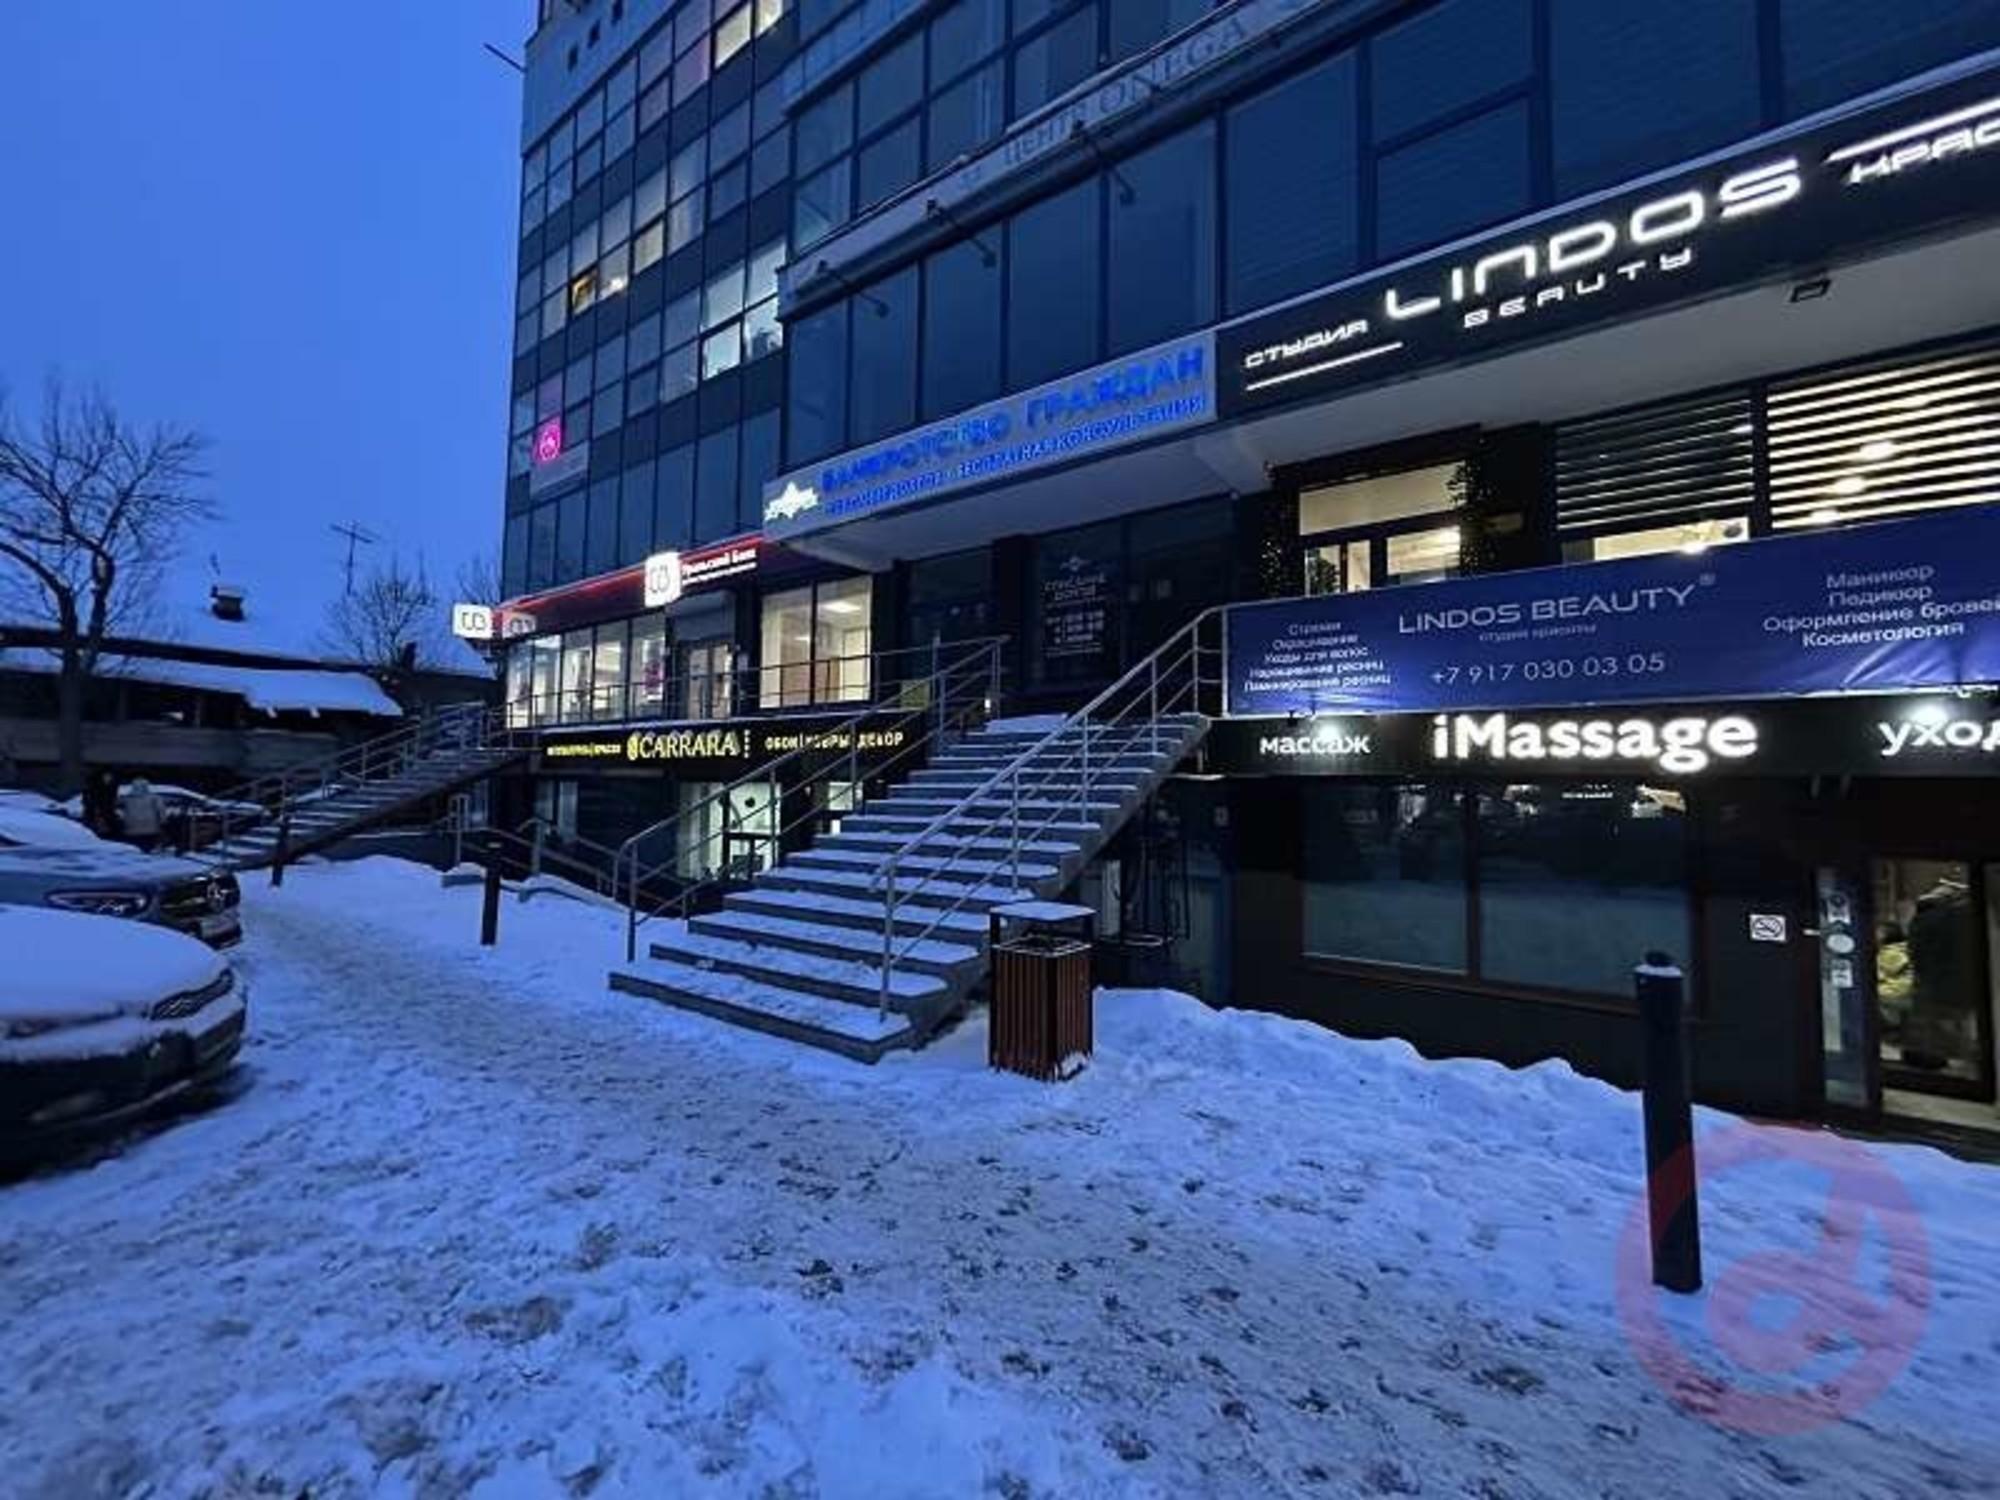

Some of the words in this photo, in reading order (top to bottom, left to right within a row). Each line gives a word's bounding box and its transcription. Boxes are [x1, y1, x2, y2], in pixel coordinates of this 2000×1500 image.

[1385, 157, 1802, 319] LINDOS
[1463, 247, 1691, 328] BEAUTY
[1245, 319, 1369, 368] СТУДИЯ
[1399, 604, 1522, 634] LINDOS
[1531, 583, 1696, 621] BEAUTY
[1763, 607, 1914, 633] Оформление
[1802, 622, 1965, 648] Косметология
[1469, 664, 1515, 684] 917
[1523, 659, 1575, 682] 030
[1583, 656, 1618, 676] 03
[1628, 652, 1666, 674] 05
[640, 731, 739, 759] CARRARA
[1259, 736, 1371, 754] массаж
[1433, 714, 1758, 773] iMassage
